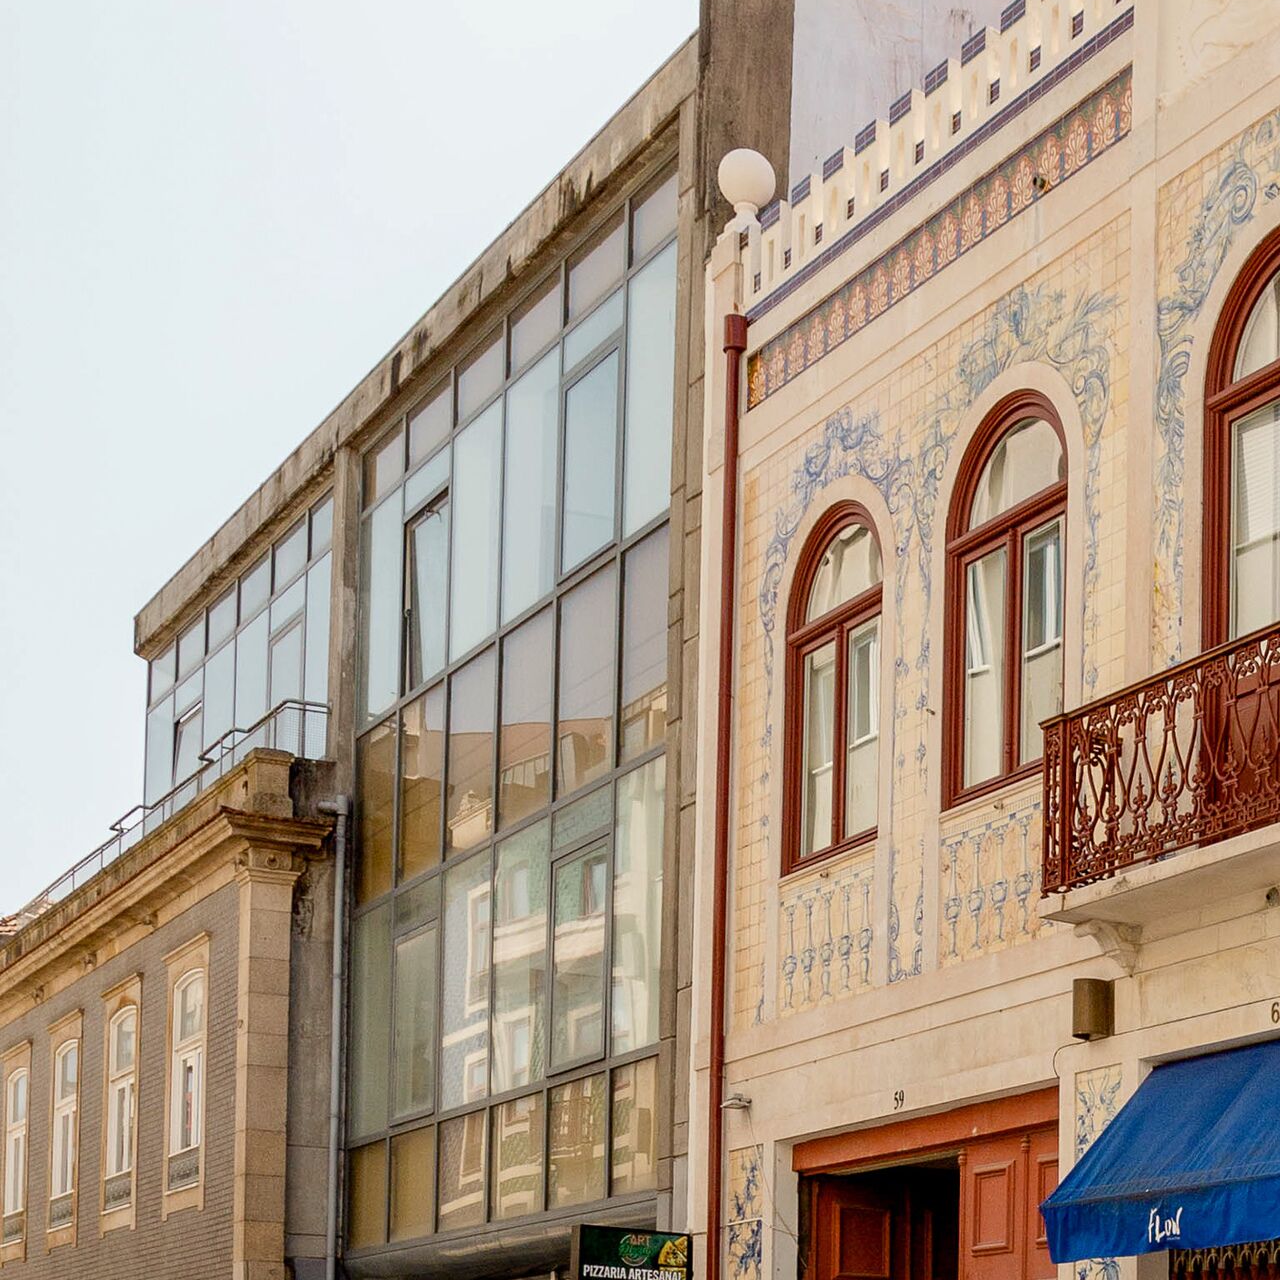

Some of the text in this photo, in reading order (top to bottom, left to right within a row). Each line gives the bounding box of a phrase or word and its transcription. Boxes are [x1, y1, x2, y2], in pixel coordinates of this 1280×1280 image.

[893, 1089, 905, 1111] 59
[629, 1233, 652, 1247] ART
[583, 1264, 627, 1280] PIZZARIA
